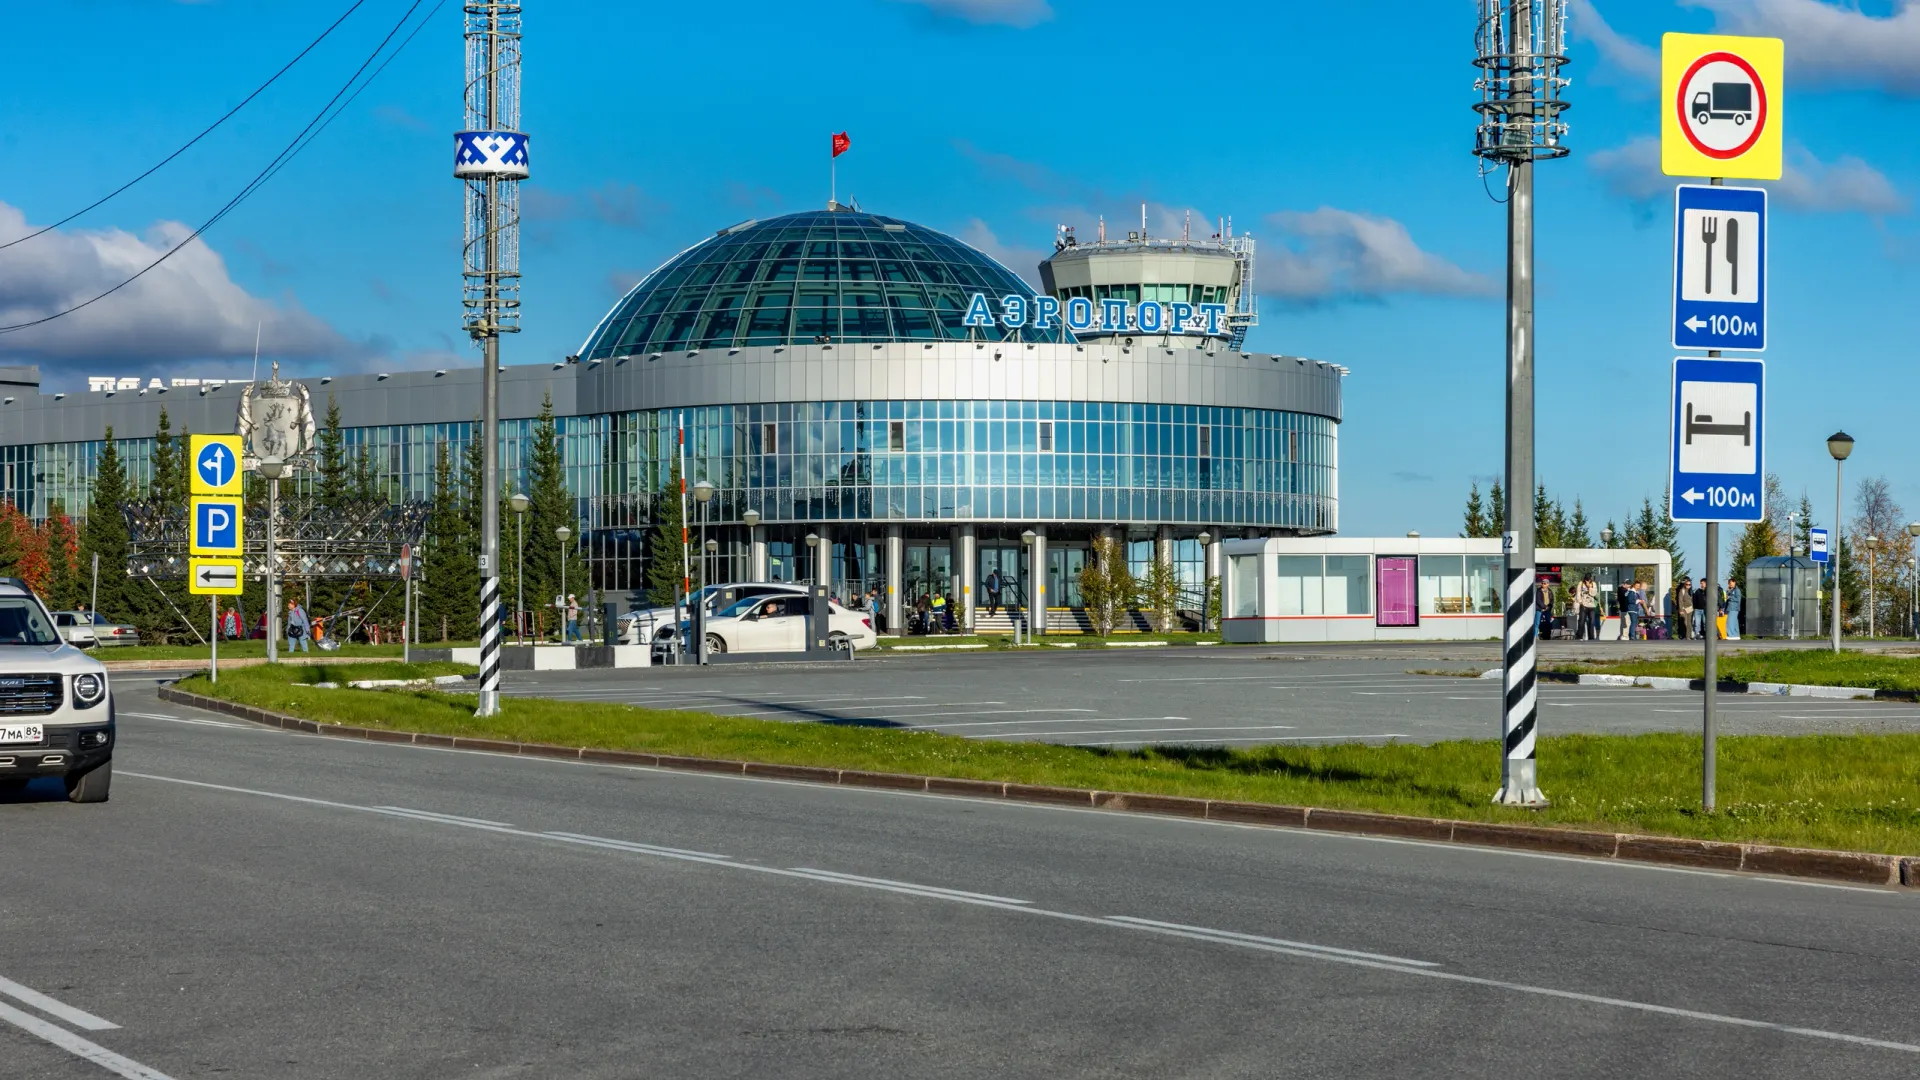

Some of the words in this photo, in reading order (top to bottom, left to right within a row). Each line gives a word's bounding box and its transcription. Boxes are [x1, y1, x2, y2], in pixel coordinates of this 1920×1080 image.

[964, 292, 1226, 336] АЭРОПОРТ
[207, 508, 230, 543] P
[26, 726, 38, 736] 89
